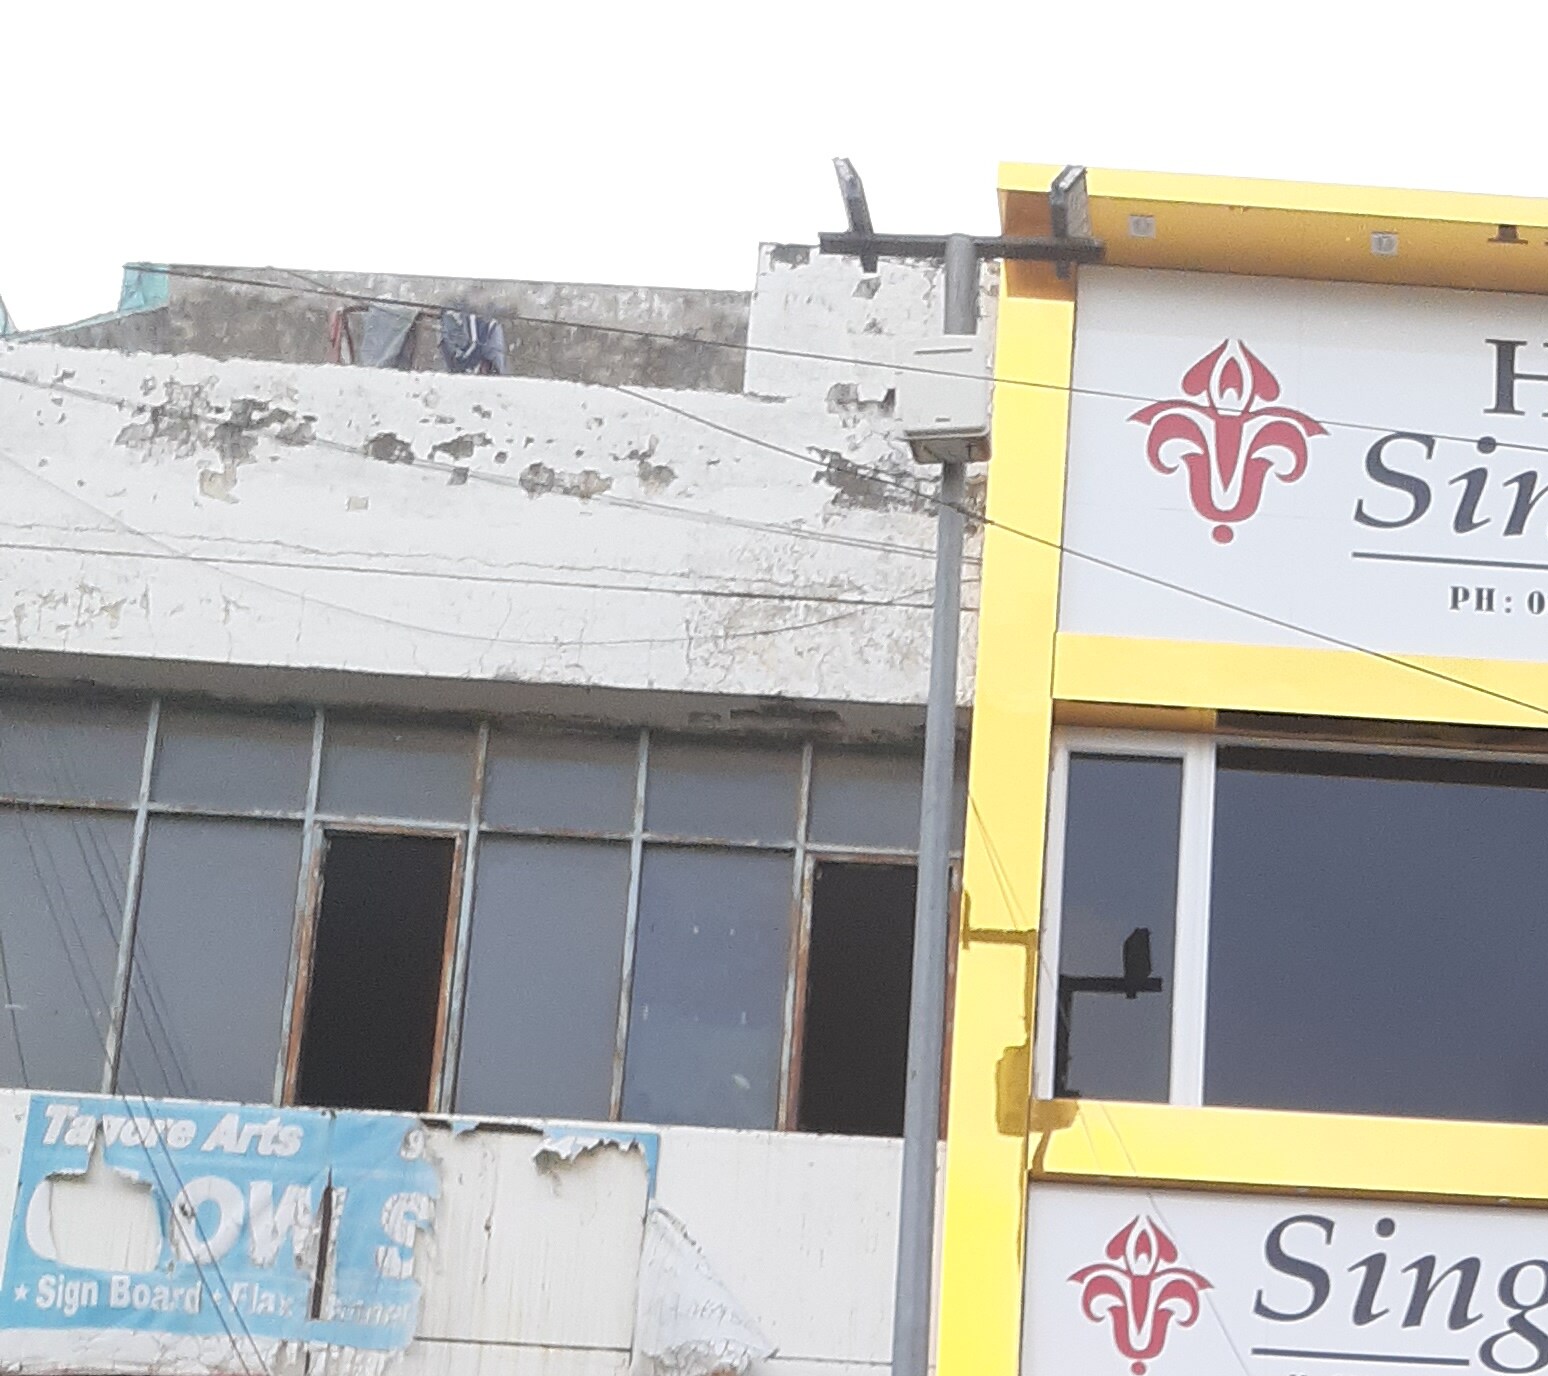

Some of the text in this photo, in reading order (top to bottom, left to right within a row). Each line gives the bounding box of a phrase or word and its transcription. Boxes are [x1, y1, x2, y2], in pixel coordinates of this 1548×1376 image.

[202, 1116, 304, 1157] Arts
[36, 1273, 98, 1316] Sign
[110, 1275, 201, 1315] Board
